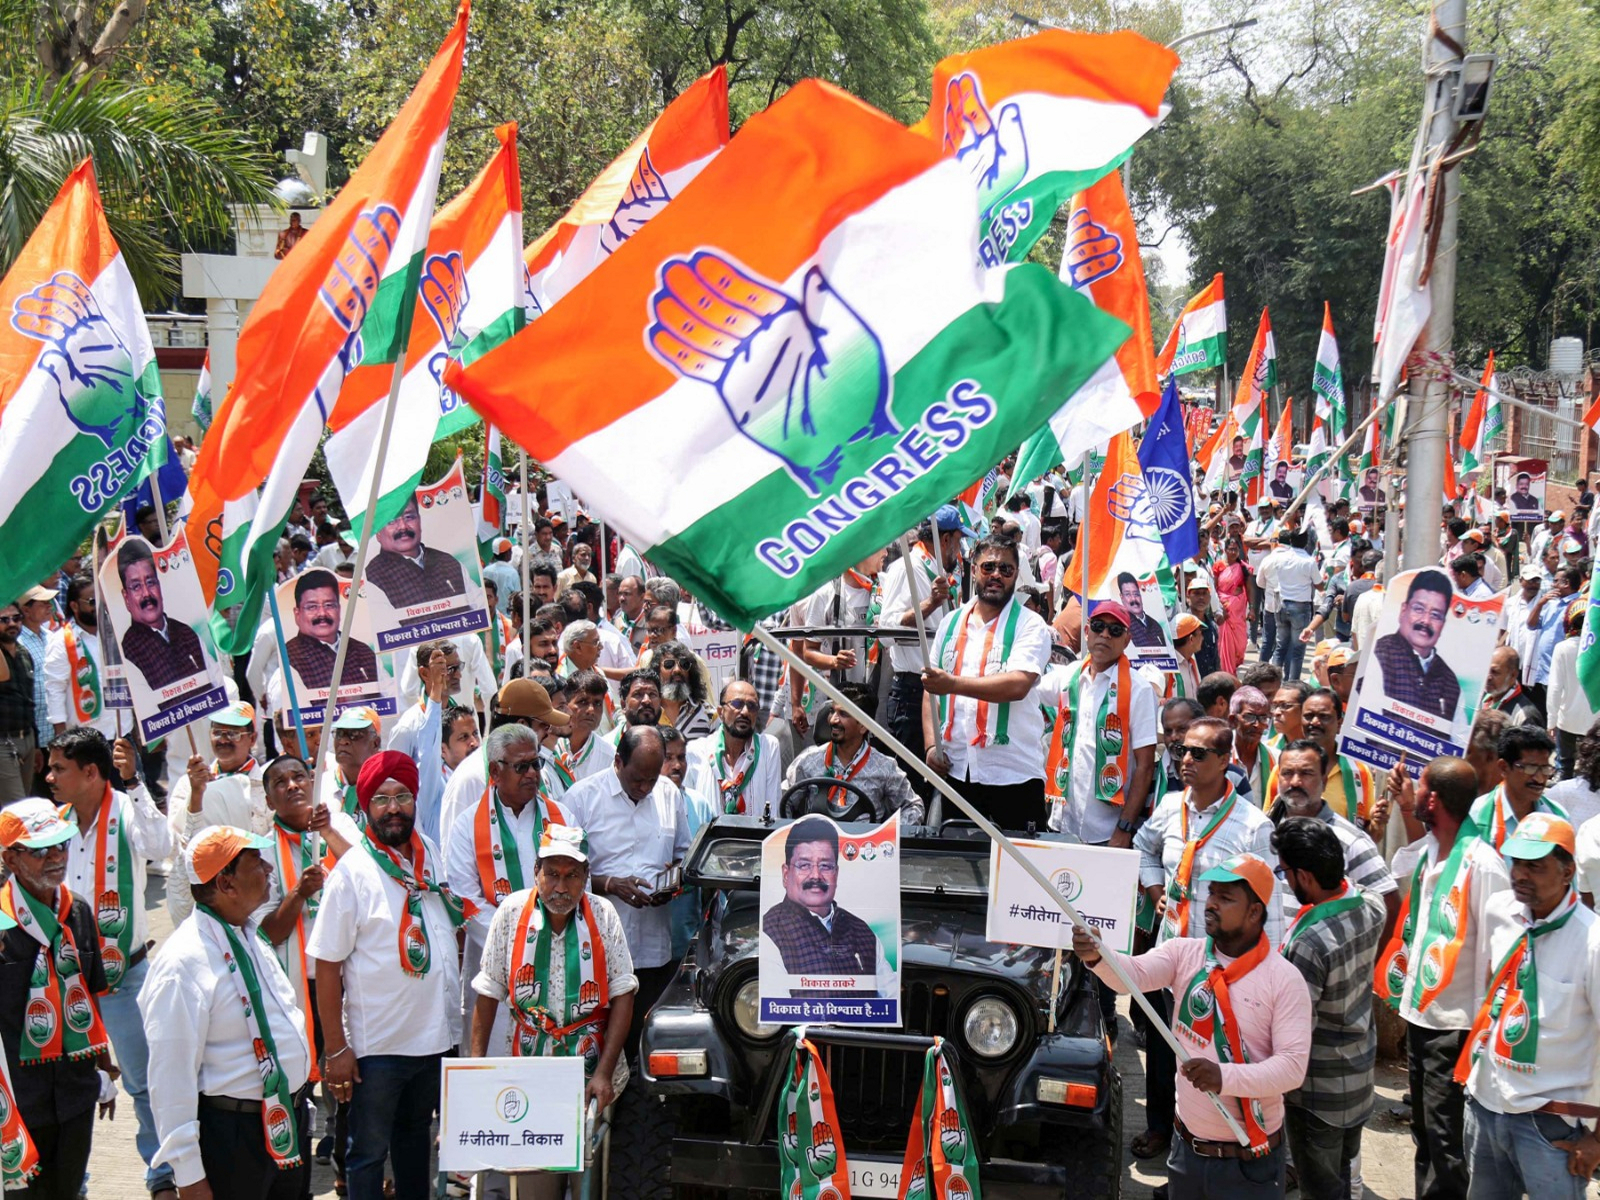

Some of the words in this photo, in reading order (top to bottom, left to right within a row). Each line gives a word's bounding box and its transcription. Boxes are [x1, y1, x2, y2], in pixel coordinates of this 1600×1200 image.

[757, 381, 995, 577] CONGRESS
[384, 631, 412, 644] विकास
[412, 627, 420, 639] है
[420, 625, 430, 636] तो
[431, 619, 461, 633] विश्वास
[147, 716, 171, 733] विकास
[169, 711, 177, 724] है
[176, 708, 185, 720] तो
[184, 701, 208, 718] विश्वास
[1362, 712, 1389, 732] विकास
[1388, 723, 1395, 737] है
[1395, 727, 1405, 739] तो
[1406, 730, 1436, 751] विश्वास
[1347, 740, 1371, 757] विकास
[800, 977, 830, 988] विकास
[832, 977, 856, 988] ठाकरे
[769, 1001, 801, 1014] विकास
[803, 1001, 811, 1016] है
[812, 1002, 824, 1015] तो
[826, 1003, 863, 1016] विश्वास
[879, 1172, 902, 1189] 94
